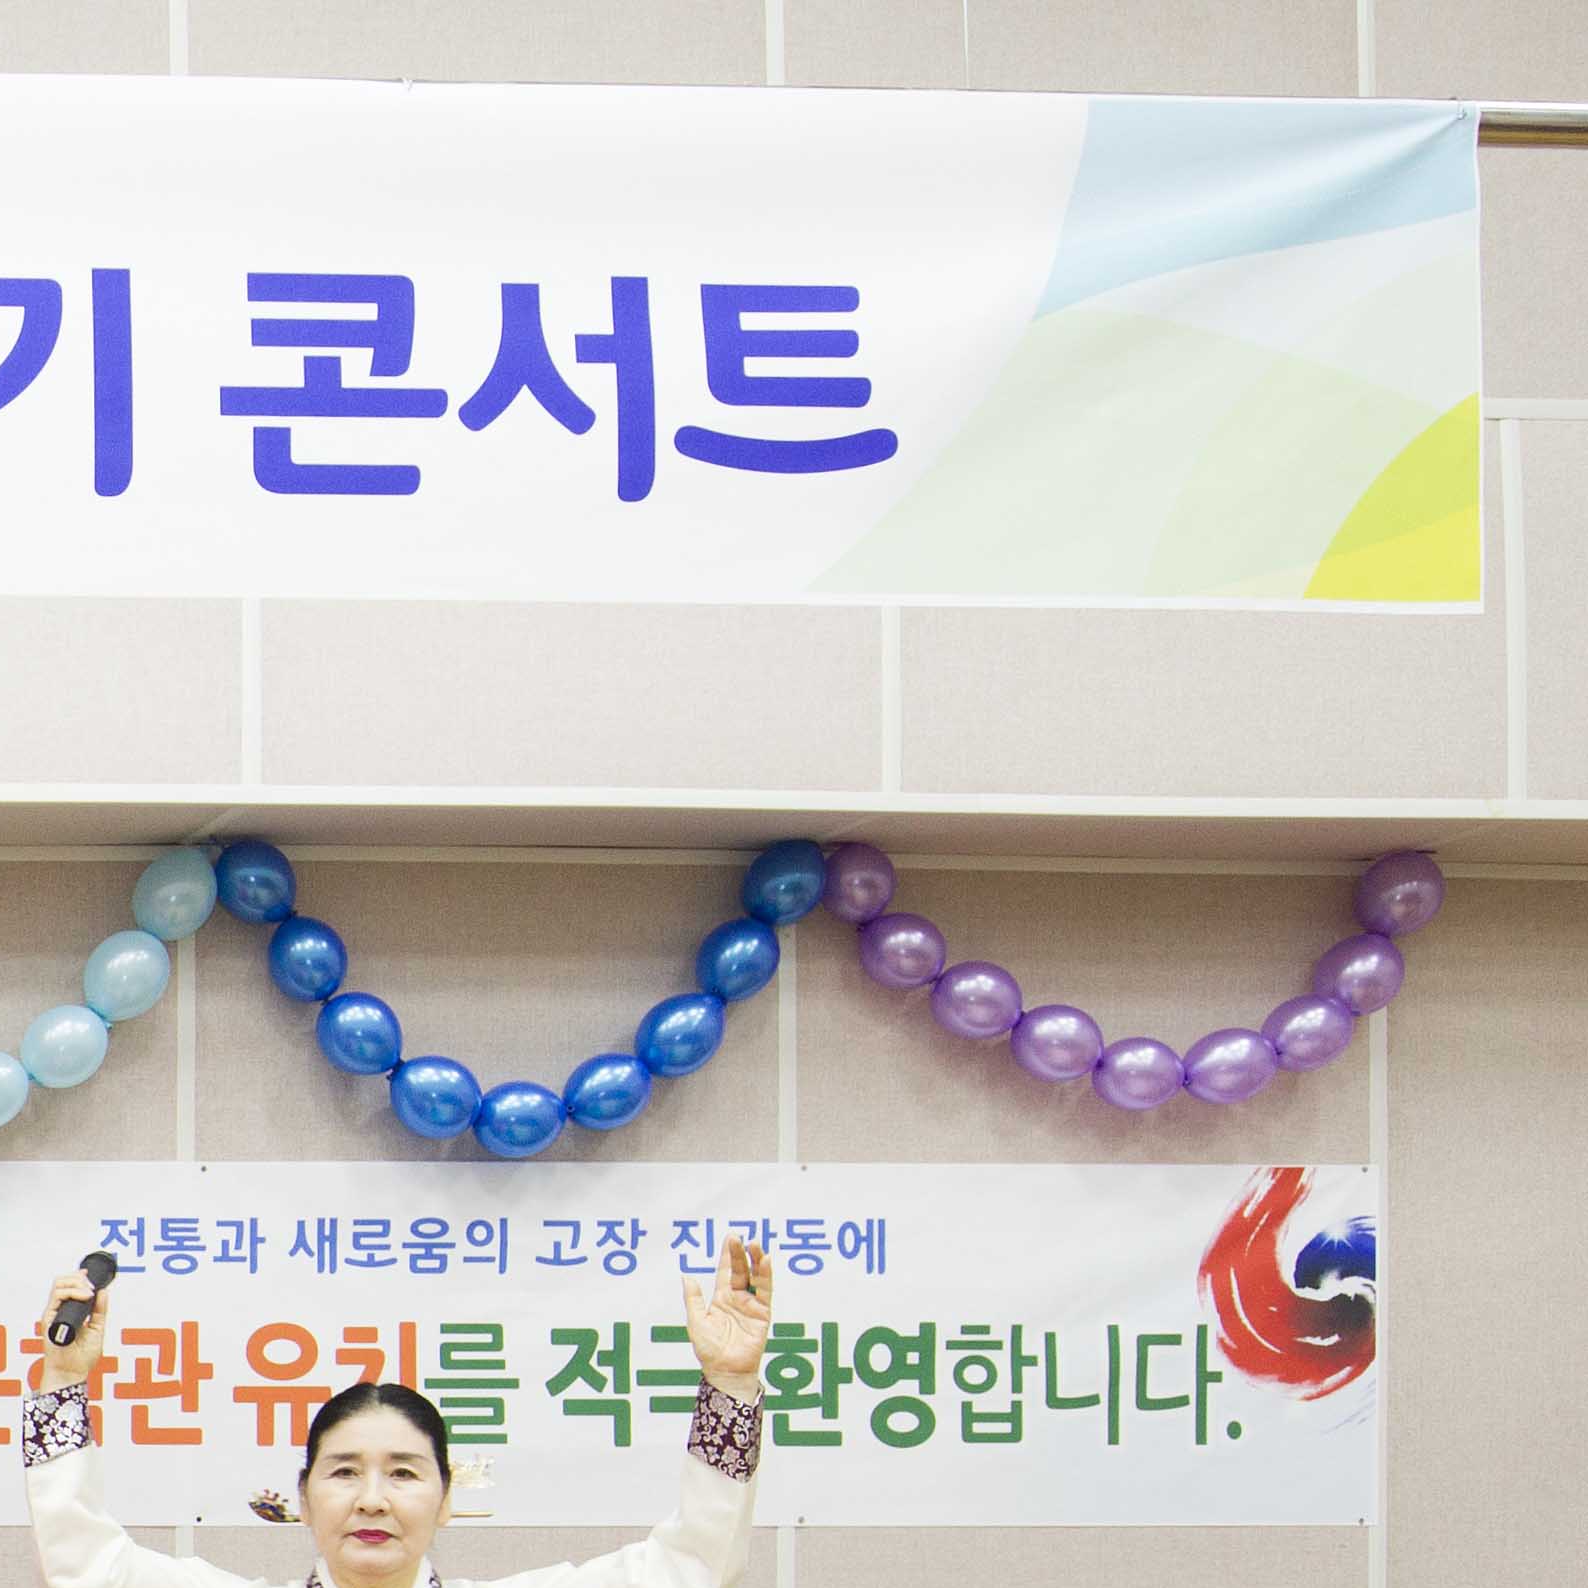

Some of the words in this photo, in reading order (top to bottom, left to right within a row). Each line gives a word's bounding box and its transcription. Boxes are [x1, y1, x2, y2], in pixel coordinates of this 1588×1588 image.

[219, 272, 898, 503] 콘서트
[99, 1216, 266, 1275] 전통과
[289, 1216, 508, 1275] 새로움의
[535, 1218, 648, 1276] 고장
[233, 1321, 519, 1446] 유치를
[762, 1321, 1243, 1448] 환영합니다.
